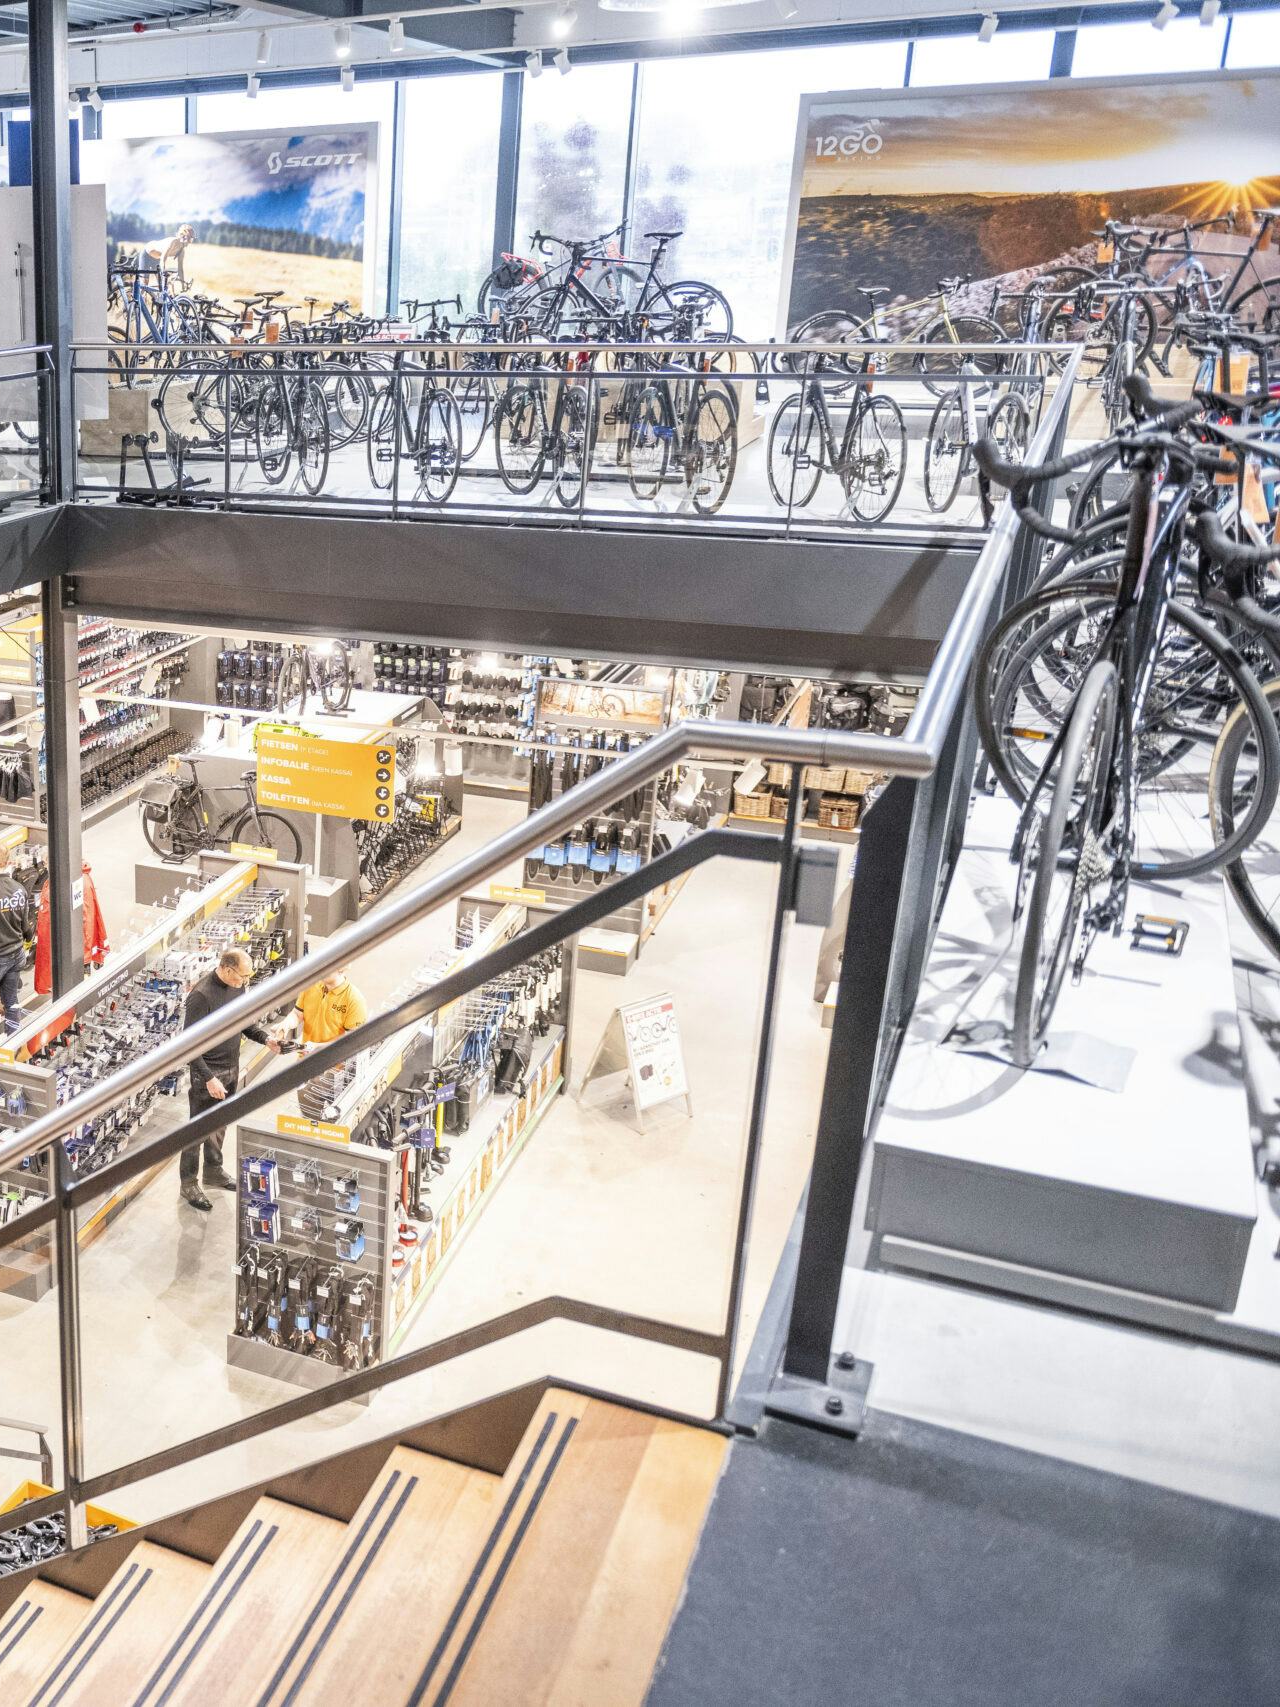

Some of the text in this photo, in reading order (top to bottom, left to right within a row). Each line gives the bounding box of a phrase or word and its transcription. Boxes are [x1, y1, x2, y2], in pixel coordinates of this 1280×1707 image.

[815, 134, 883, 156] 12GO
[283, 153, 363, 168] SCOTT
[261, 738, 299, 752] FIETSEN
[261, 756, 310, 771] INFOBALIE
[261, 774, 291, 786] KASSA
[261, 790, 310, 806] TOILETTEN
[0, 895, 26, 910] 12GO
[73, 890, 82, 901] WC
